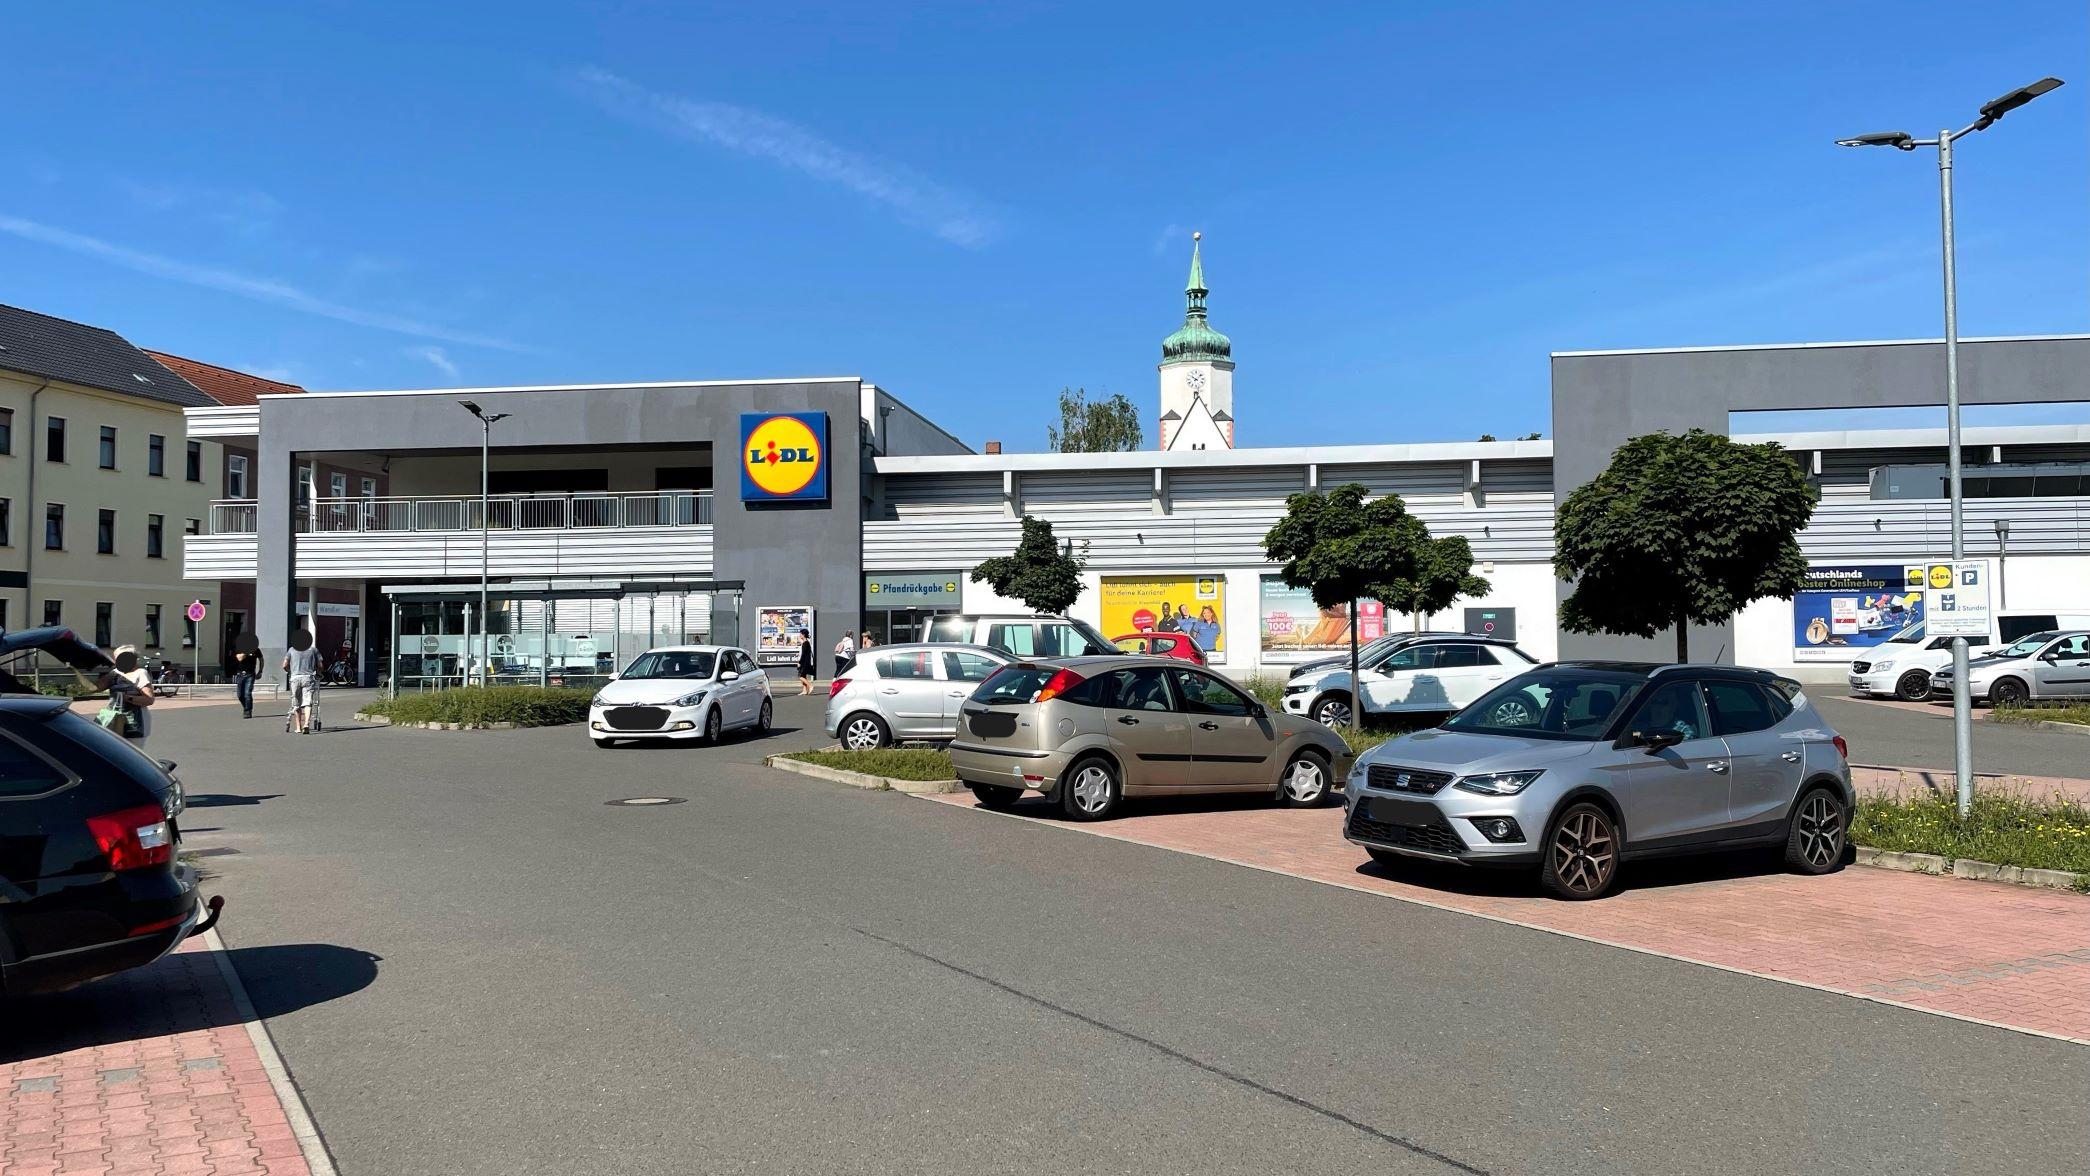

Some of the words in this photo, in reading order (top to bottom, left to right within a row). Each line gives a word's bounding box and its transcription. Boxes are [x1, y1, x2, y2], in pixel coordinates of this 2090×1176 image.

[1804, 570, 1863, 579] eutschlands
[1965, 572, 1975, 583] P
[883, 583, 943, 595] Pfandrückgabe
[1829, 579, 1885, 589] Onlineshop
[1963, 604, 1987, 612] Stunden
[1268, 622, 1293, 632] 100€
[1813, 627, 1820, 640] 1
